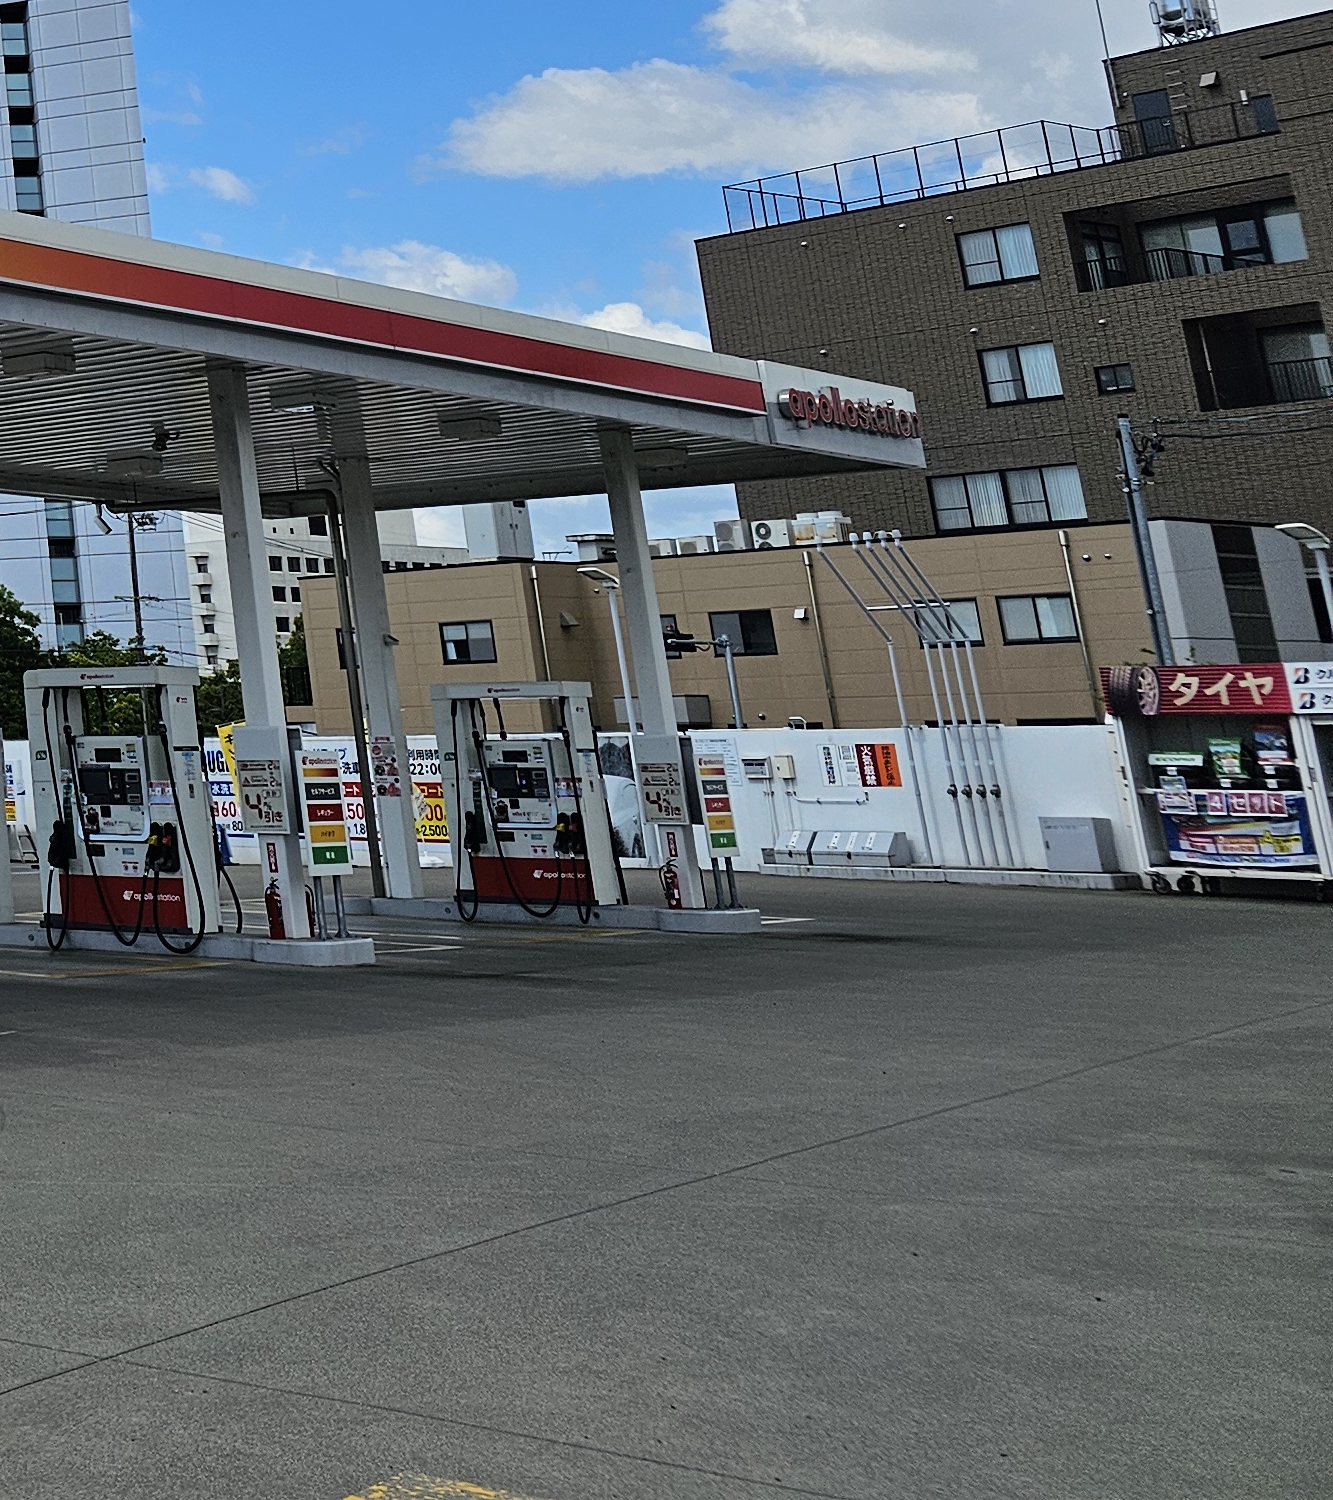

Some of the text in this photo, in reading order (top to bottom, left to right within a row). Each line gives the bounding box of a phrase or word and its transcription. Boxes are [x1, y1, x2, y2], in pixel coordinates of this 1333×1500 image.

[787, 386, 922, 438] apollostation
[1168, 672, 1274, 707] タイヤ
[860, 744, 878, 786] 火気厳禁
[244, 793, 263, 820] 4
[264, 810, 283, 824] 引き
